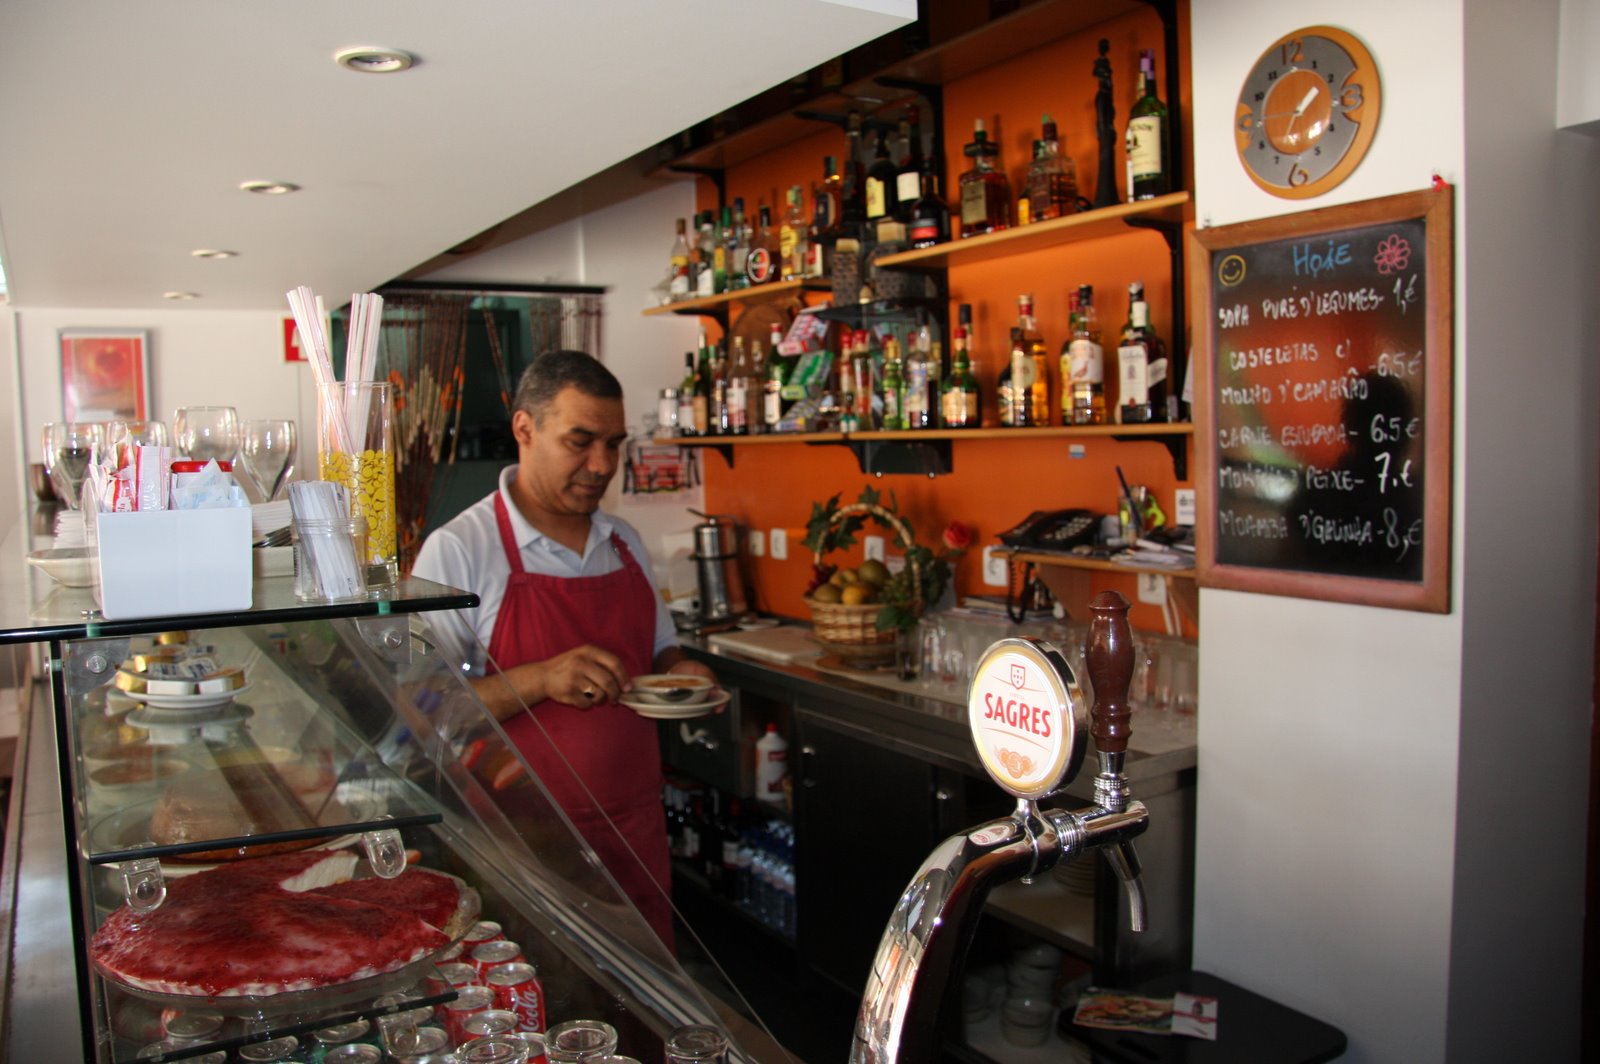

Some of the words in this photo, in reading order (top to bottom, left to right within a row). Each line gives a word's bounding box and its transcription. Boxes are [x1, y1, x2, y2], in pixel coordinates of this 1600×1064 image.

[1341, 83, 1364, 113] 3
[1288, 163, 1309, 188] 6
[985, 692, 1052, 738] SAGRES
[518, 990, 540, 1031] Cola
